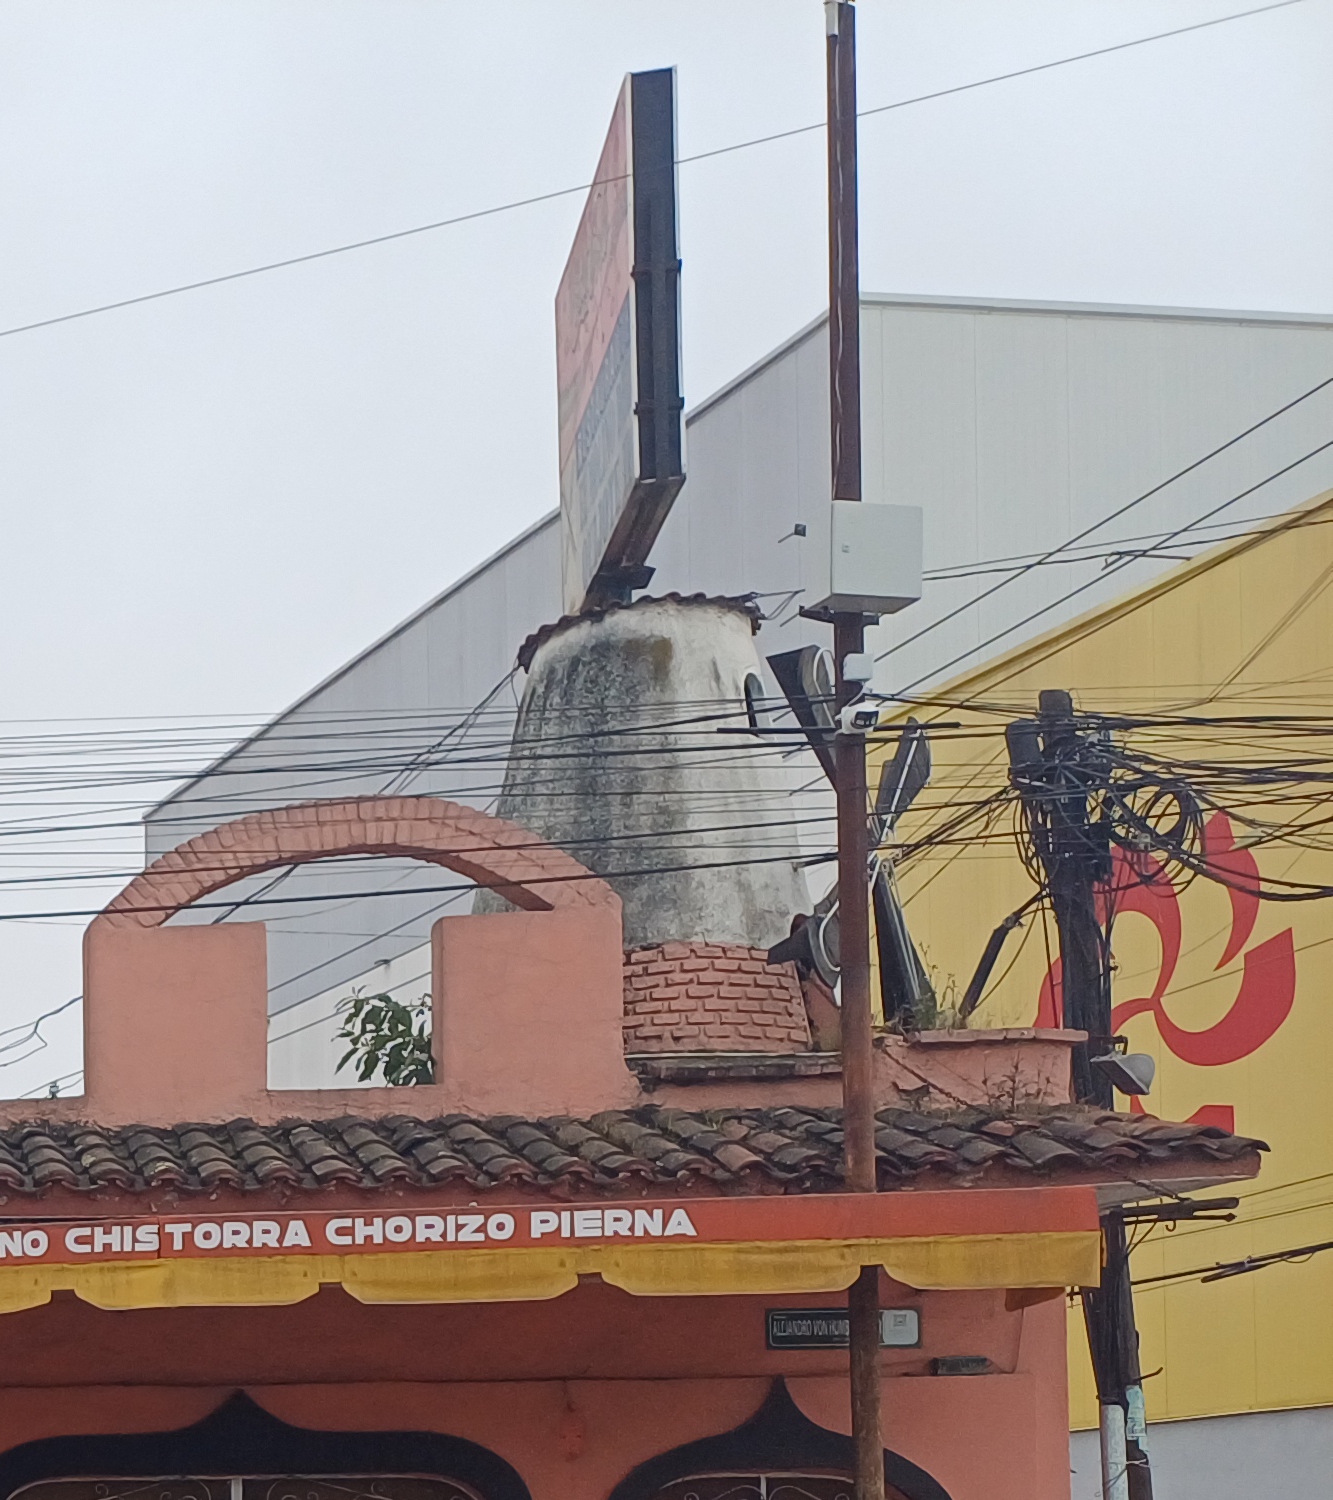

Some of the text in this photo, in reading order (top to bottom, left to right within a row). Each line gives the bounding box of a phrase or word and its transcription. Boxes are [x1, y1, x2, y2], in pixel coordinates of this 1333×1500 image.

[63, 1220, 312, 1255] CHISTORRA
[325, 1212, 515, 1246] CHORIZO
[530, 1208, 698, 1238] PIERNA
